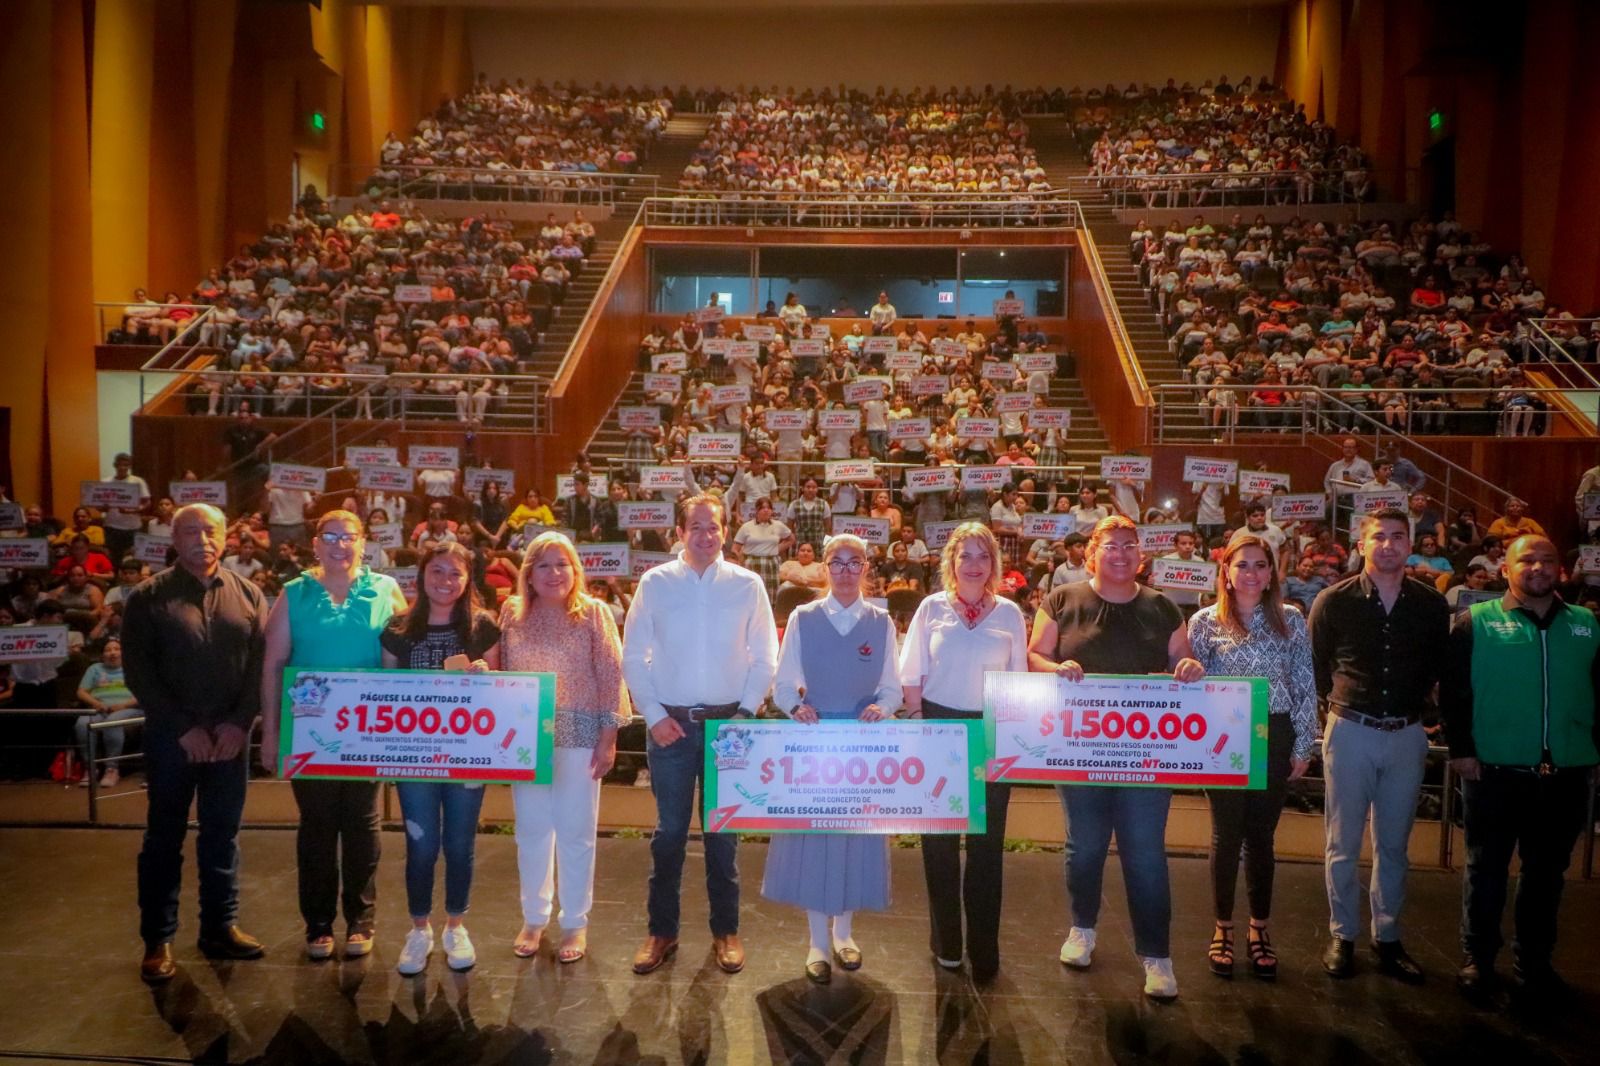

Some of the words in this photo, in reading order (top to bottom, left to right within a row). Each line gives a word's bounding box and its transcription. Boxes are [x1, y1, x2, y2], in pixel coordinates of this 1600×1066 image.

[1165, 572, 1208, 582] CONTODO
[360, 692, 398, 702] PÁGUESE
[414, 695, 459, 703] CANTIDAD
[1065, 697, 1104, 707] PÁGUESE
[1121, 700, 1167, 708] CANTIDAD
[1170, 701, 1181, 709] DE
[785, 743, 824, 752] PÁGUESE
[376, 767, 450, 777] PREPARATORIA
[1088, 773, 1156, 782] UNIVERSIDAD
[811, 819, 872, 828] SECUNDARIA
